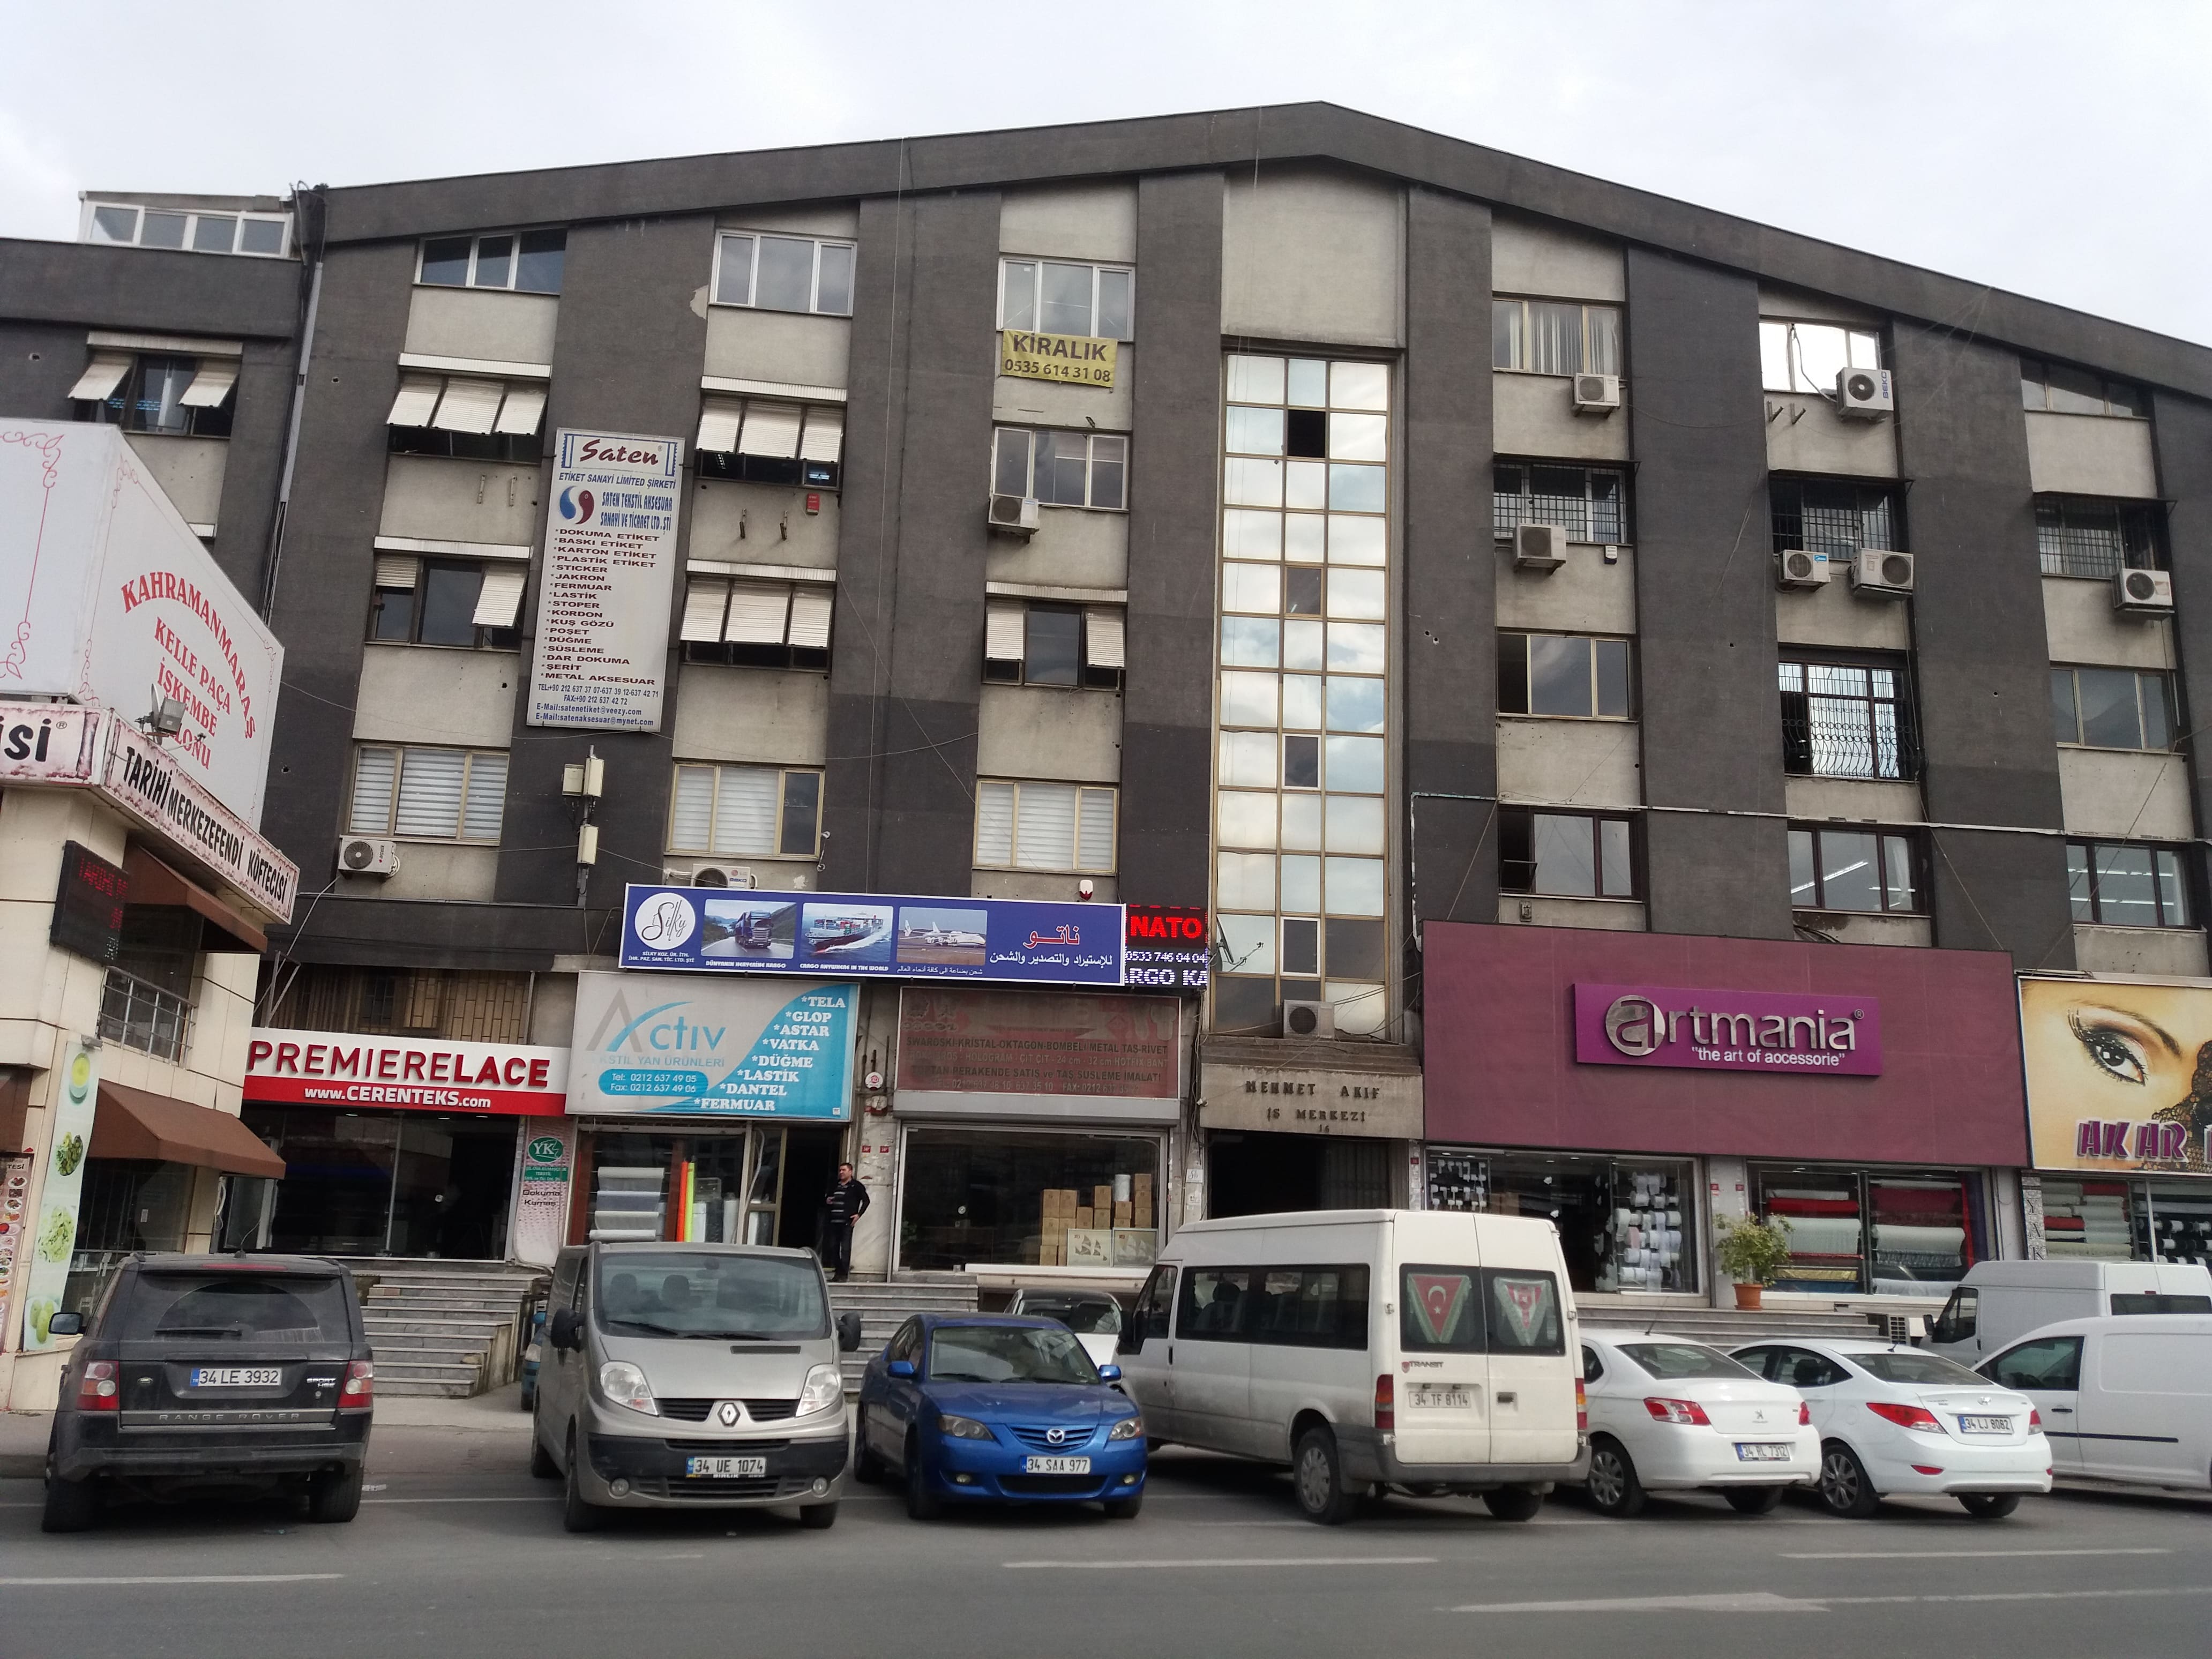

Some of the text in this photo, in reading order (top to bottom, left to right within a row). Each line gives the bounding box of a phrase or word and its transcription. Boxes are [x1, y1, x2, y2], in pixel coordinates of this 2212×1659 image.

[1013, 333, 1107, 362] KİRALIK
[1005, 359, 1110, 382] 0535 614 31 08
[580, 438, 659, 465] Saten
[559, 471, 676, 489] ETİKET SANAYİ LİMİTED ŞİRKETİ
[602, 491, 672, 512] SATEN TEKSTİL AKSESUAR
[600, 510, 620, 527] SANAYİ
[622, 513, 627, 525] VE
[629, 511, 649, 529] TİCARET
[617, 533, 660, 541] ETİKET
[601, 541, 643, 549] ETİKET
[614, 550, 656, 559] ETİKET
[612, 559, 656, 567] ETİKET
[154, 616, 231, 715] KELLE PAÇA
[577, 656, 630, 664] DOKUMA
[589, 675, 655, 685] AKSESUAR
[170, 722, 211, 770] LONU
[123, 746, 290, 905] TARİHİ MERKEZEFENDİ KÖFTECİSİ
[641, 899, 687, 942] Silky
[1130, 916, 1202, 939] NATO
[1022, 923, 1080, 950] ناتو
[1176, 953, 1191, 963] 04
[1192, 954, 1206, 963] 04
[1605, 995, 1856, 1056] artmania
[638, 1056, 661, 1065] YAN
[1724, 1050, 1744, 1063] art
[1747, 1050, 1761, 1063] of
[612, 1073, 697, 1083] Tel: 0212 637 49 05
[610, 1083, 627, 1091] Fax:
[630, 1083, 652, 1092] 0212
[654, 1084, 670, 1092] 637
[304, 1086, 491, 1108] www.CERENTEKS.com
[2077, 1120, 2187, 1160] AKAR
[533, 1142, 555, 1154] YK
[199, 1370, 279, 1384] 34 LE 3932
[1966, 1418, 1976, 1429] 34
[695, 1459, 763, 1473] 34 UE 1074
[1027, 1458, 1088, 1473] 34 SAA 977
